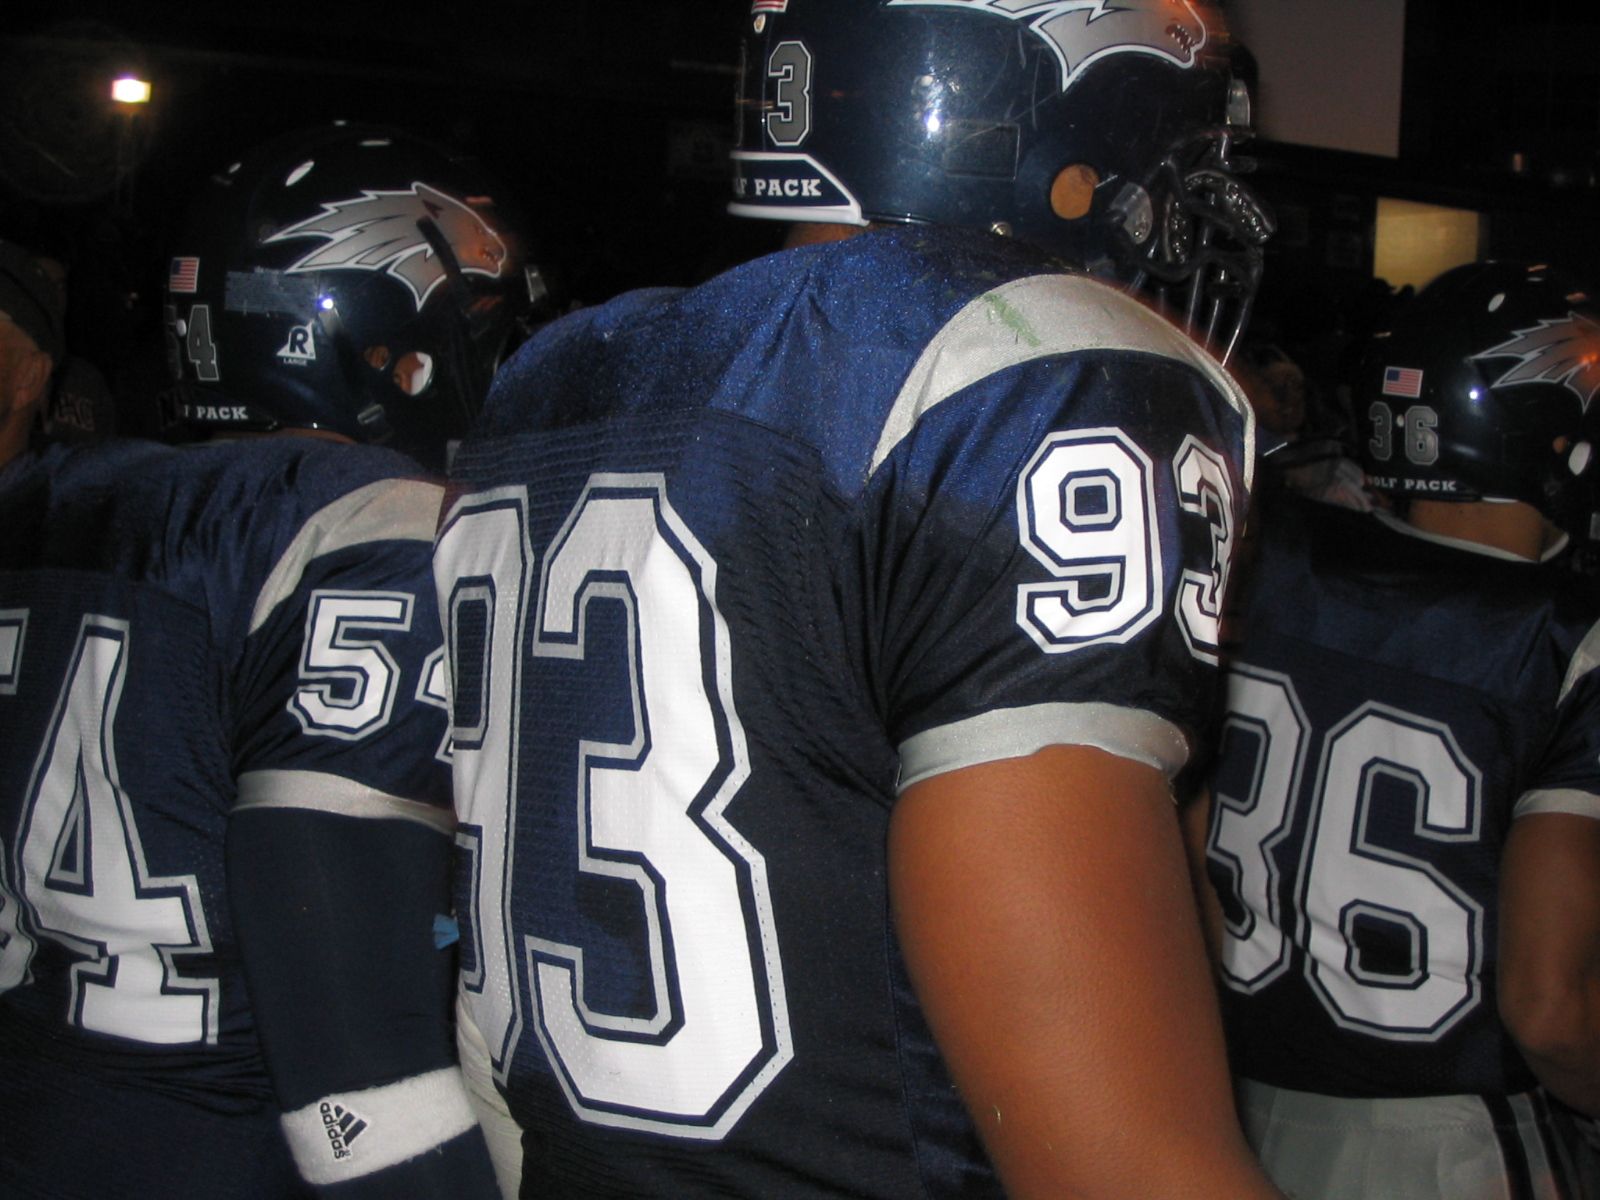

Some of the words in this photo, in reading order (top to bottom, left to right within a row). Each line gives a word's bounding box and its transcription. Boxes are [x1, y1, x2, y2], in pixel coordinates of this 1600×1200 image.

[767, 40, 811, 146] 3
[754, 178, 822, 196] PACK
[196, 405, 249, 420] PACK
[1369, 401, 1439, 466] 36
[1404, 478, 1457, 492] PACK
[1016, 426, 1234, 667] 93
[433, 472, 794, 1141] 93
[1206, 660, 1484, 1043] 36
[320, 1102, 347, 1159] adidas
